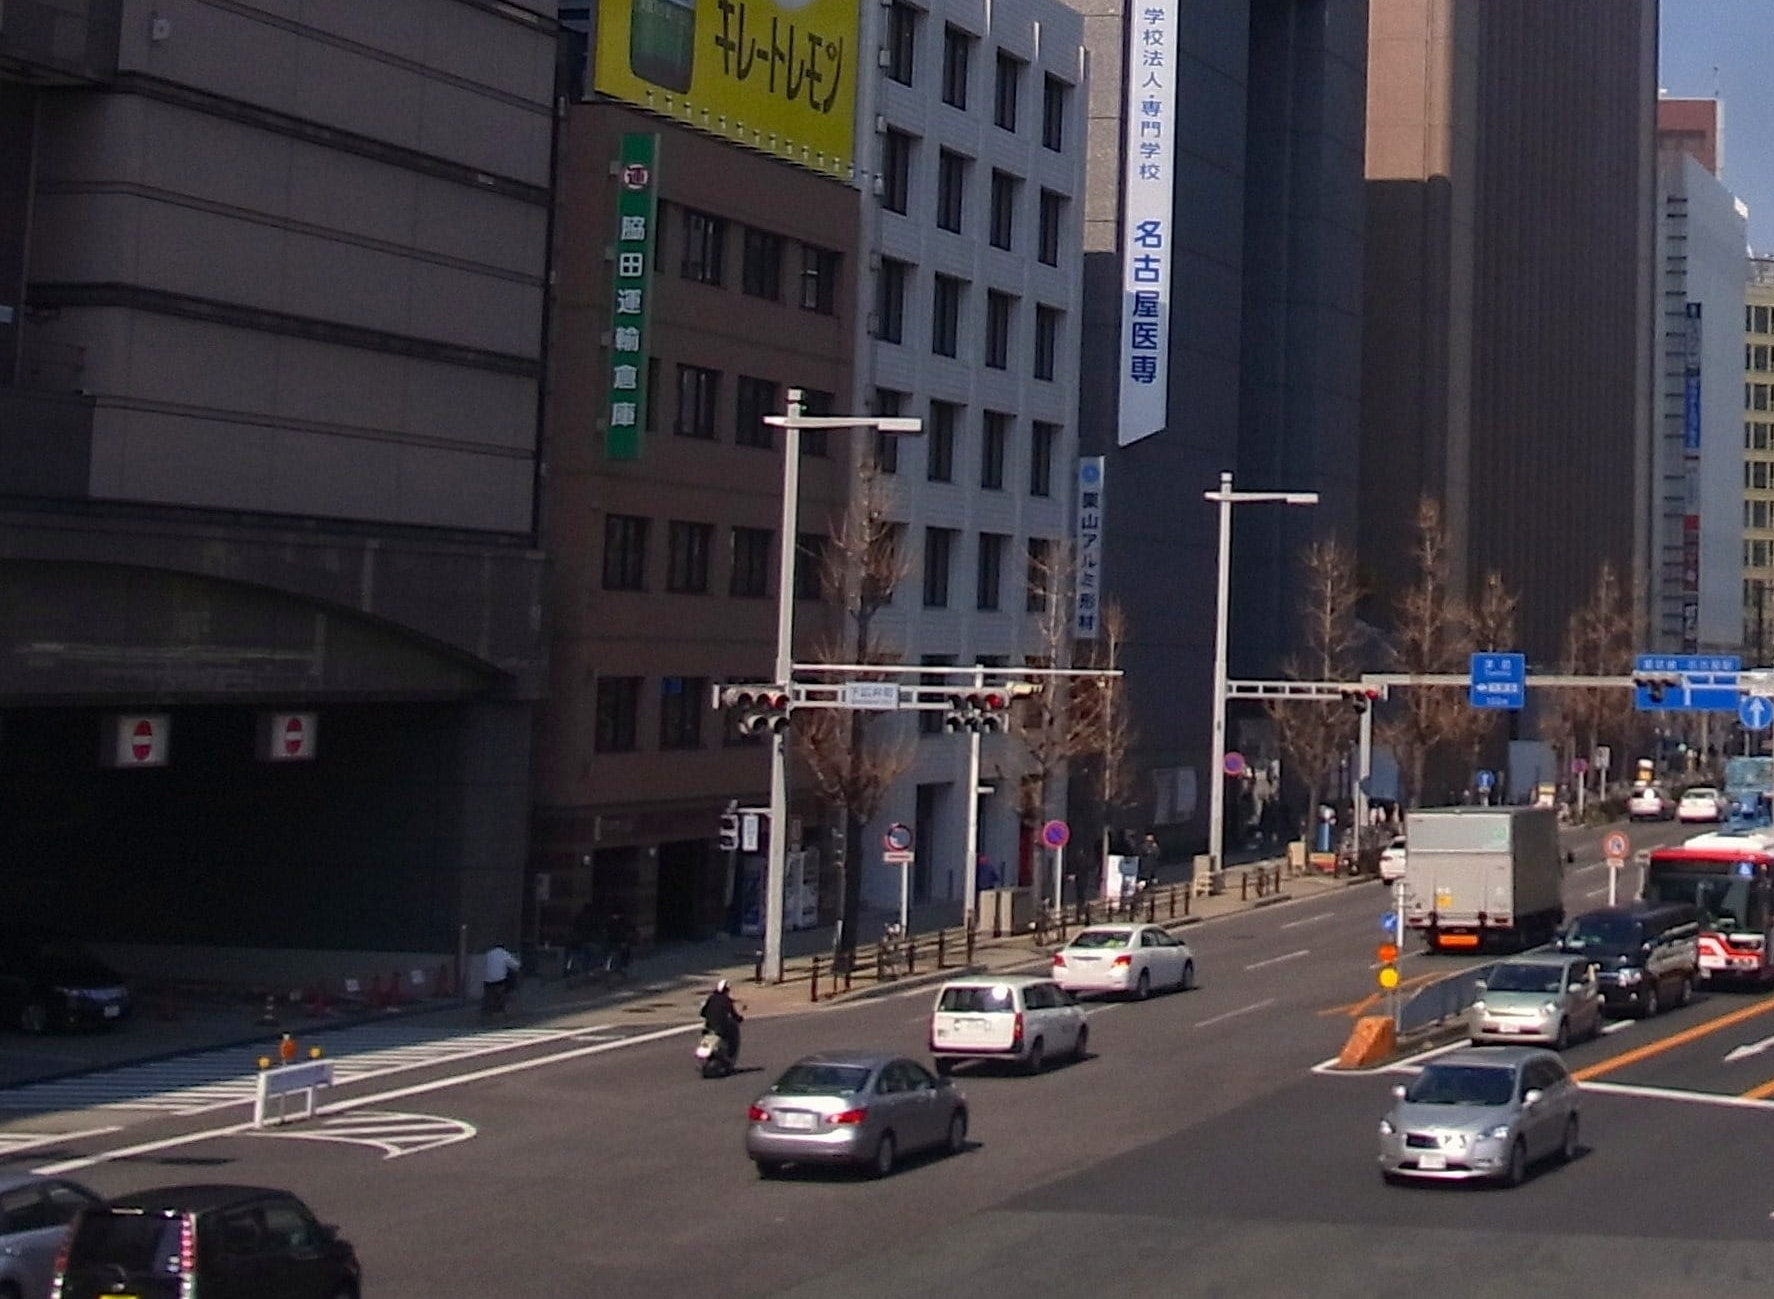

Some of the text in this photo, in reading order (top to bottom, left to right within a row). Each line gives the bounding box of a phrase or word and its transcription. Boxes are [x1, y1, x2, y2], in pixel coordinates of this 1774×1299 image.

[611, 215, 645, 427] 脇田運輸倉庫
[1130, 220, 1162, 384] 名古屋医専
